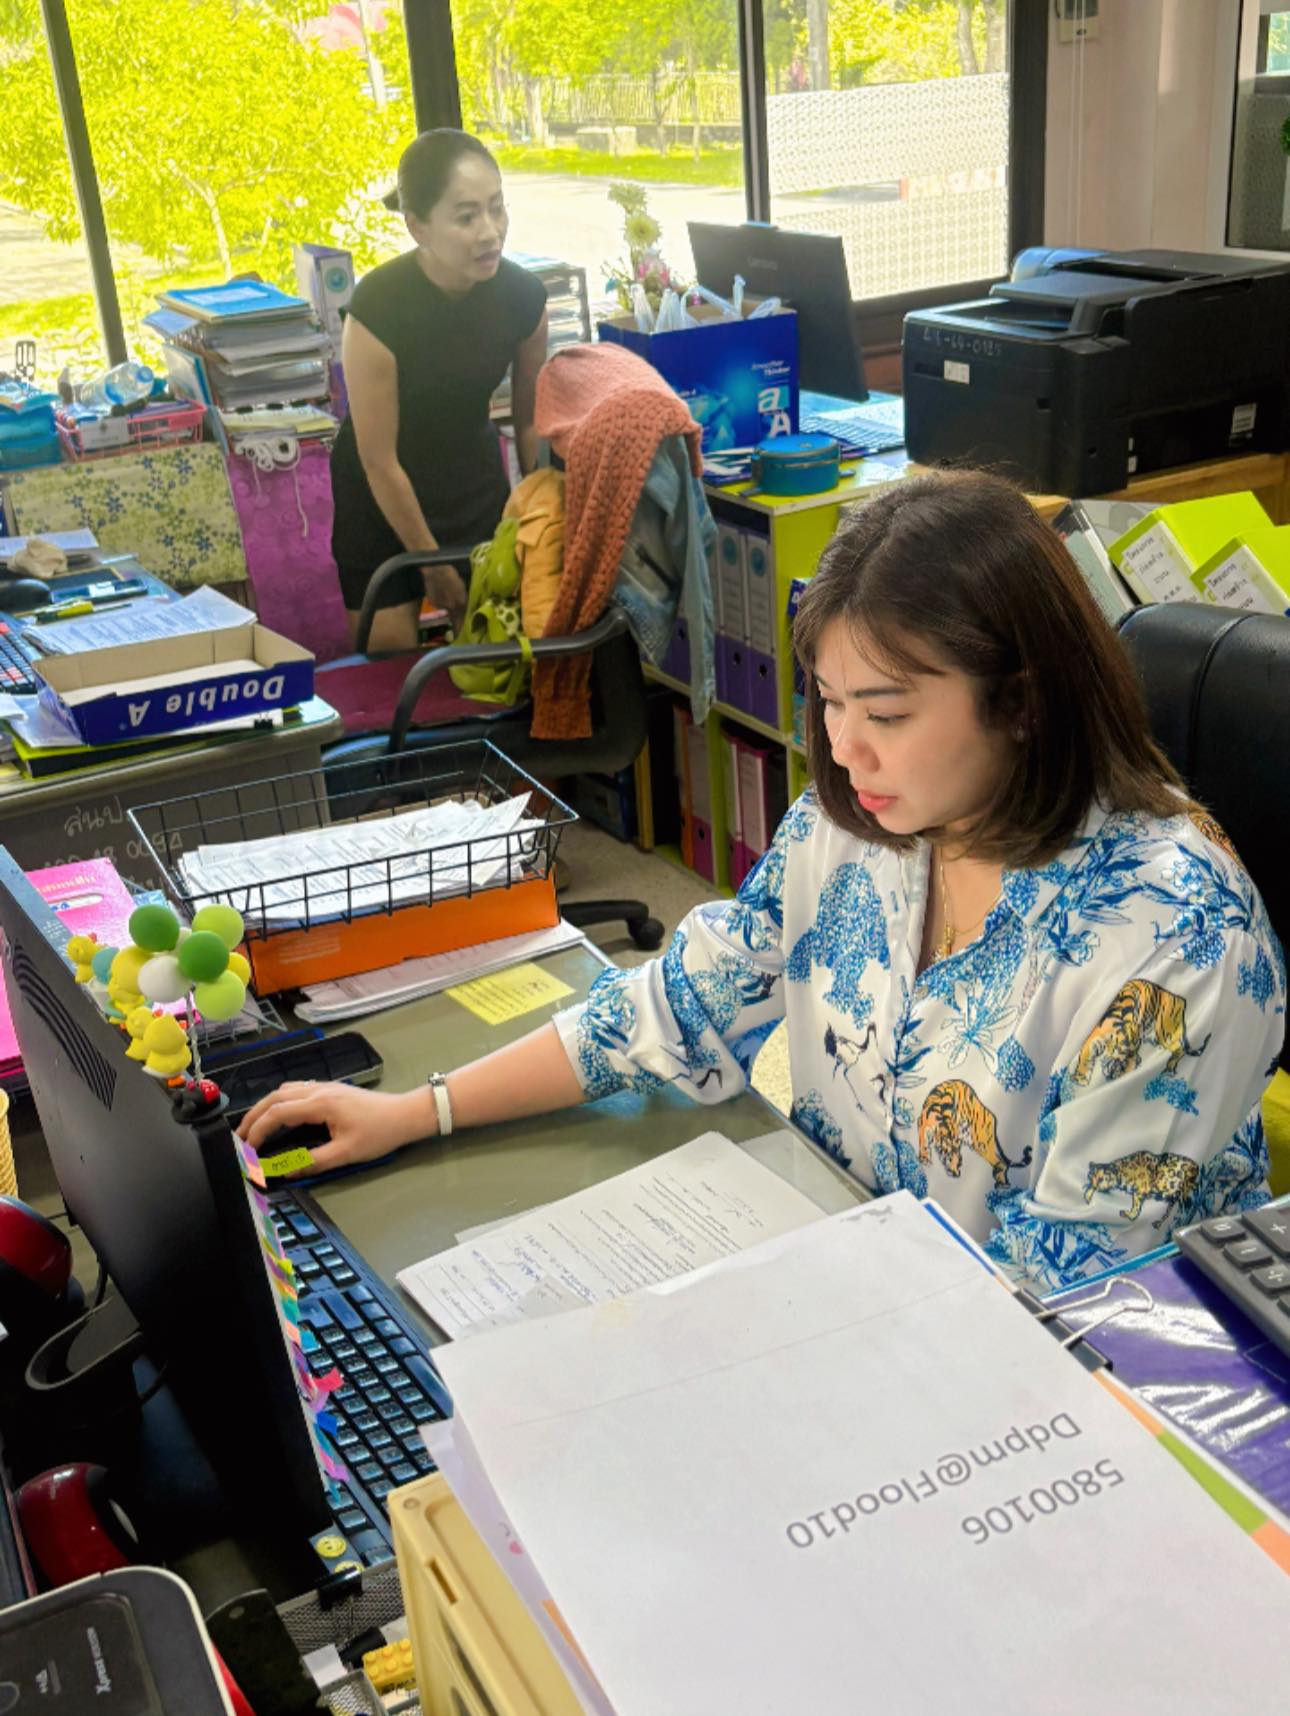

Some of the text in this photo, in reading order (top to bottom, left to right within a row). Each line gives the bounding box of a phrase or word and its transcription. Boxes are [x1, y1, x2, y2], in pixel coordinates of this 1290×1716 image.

[128, 675, 286, 728] Double A
[786, 1412, 1083, 1549] Ddpm@Flood10
[961, 1458, 1126, 1545] 5800106
